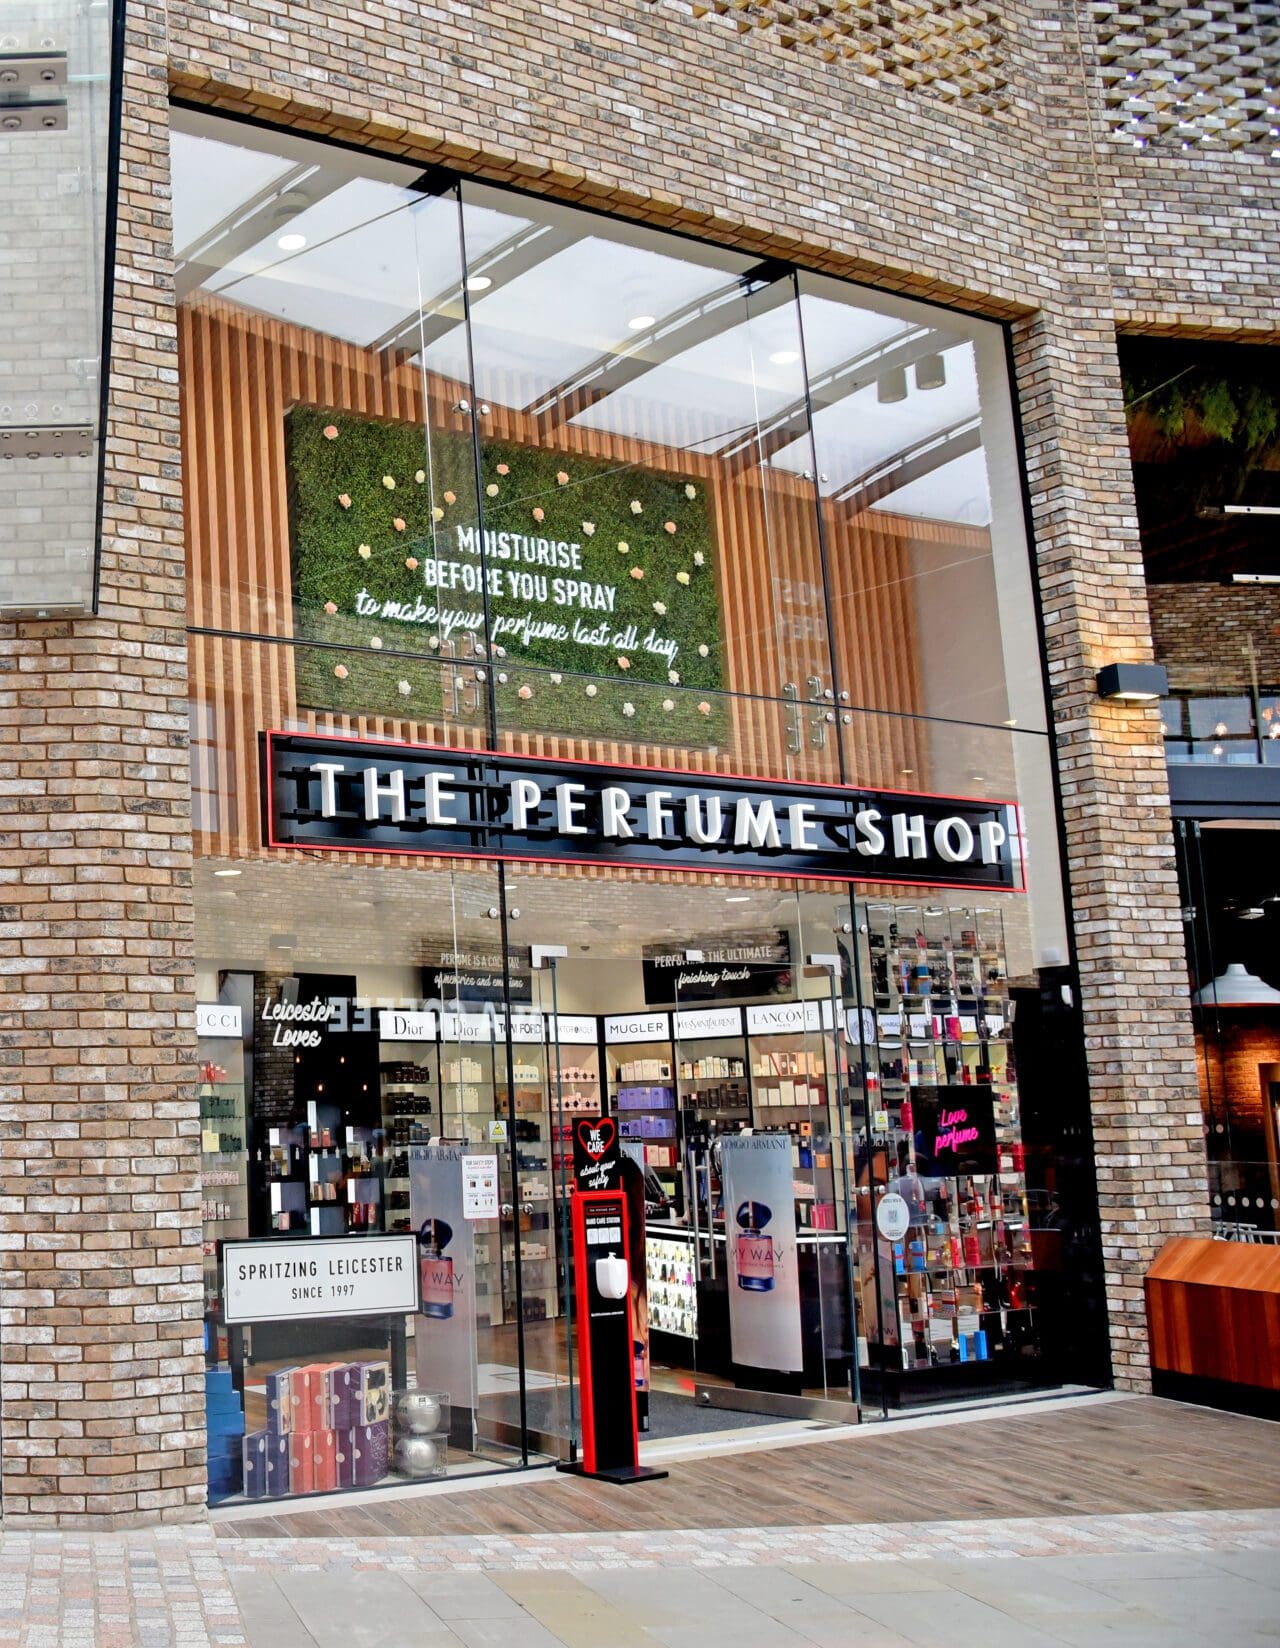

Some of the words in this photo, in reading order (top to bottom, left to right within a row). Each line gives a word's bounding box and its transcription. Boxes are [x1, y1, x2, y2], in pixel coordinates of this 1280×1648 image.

[455, 525, 582, 571] MOISTURISE
[425, 558, 505, 598] BEFORE
[507, 572, 548, 603] YOU
[554, 578, 617, 613] SPRAY
[354, 587, 381, 616] to
[381, 596, 439, 625] make
[439, 607, 486, 639] your
[491, 612, 570, 647] perfume
[573, 622, 612, 647] last
[612, 625, 640, 653] all
[642, 628, 680, 667] day
[309, 763, 457, 825] THE
[510, 779, 819, 851] PERFUME
[855, 808, 1006, 864] SHOP
[440, 952, 472, 966] PERUME
[707, 950, 725, 963] THE
[727, 945, 772, 960] ULTIMATE
[476, 974, 491, 987] and
[677, 969, 720, 989] finishing
[721, 965, 751, 981] touch
[261, 995, 336, 1022] Leicester
[272, 1022, 322, 1047] Loves
[393, 1015, 424, 1036] Dior
[452, 1016, 479, 1037] Dior
[519, 1023, 542, 1034] FORD
[610, 1022, 664, 1035] MUGLER
[941, 1109, 968, 1128] Love
[589, 1129, 601, 1141] WE
[934, 1126, 979, 1157] perfume
[587, 1141, 605, 1153] CARE
[752, 1139, 787, 1150] ARMANI
[588, 1175, 610, 1190] safety
[751, 1249, 784, 1262] WAY
[239, 1260, 318, 1281] SPRITZING
[329, 1256, 403, 1276] LEICESTER
[432, 1273, 465, 1287] WAY
[291, 1286, 323, 1300] SINCE
[331, 1285, 355, 1298] 1997
